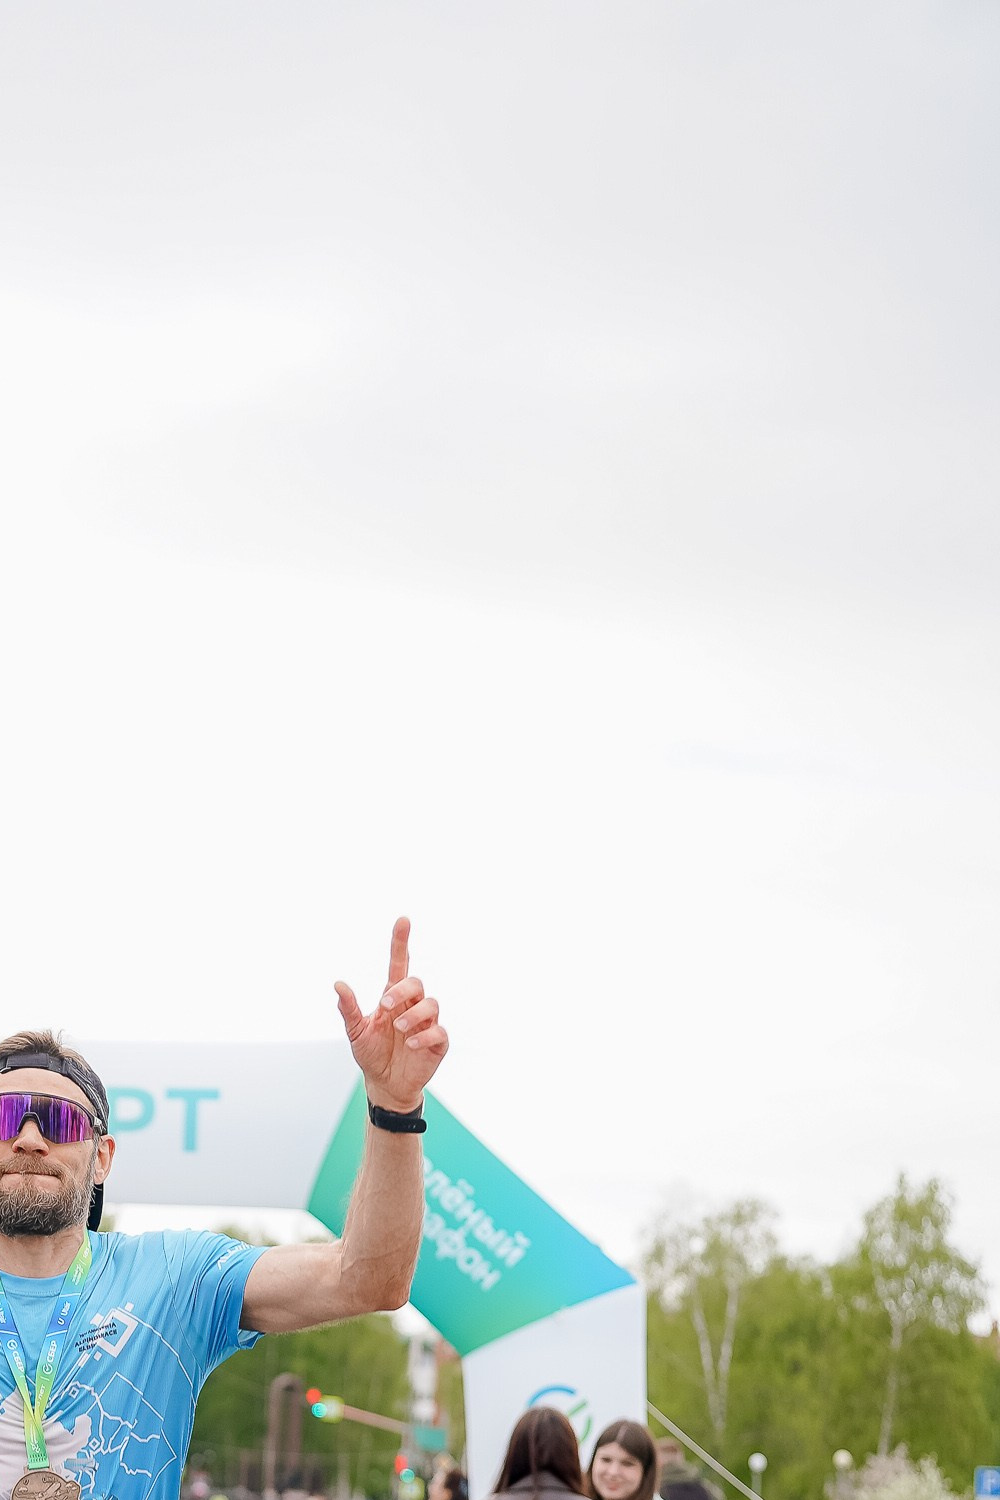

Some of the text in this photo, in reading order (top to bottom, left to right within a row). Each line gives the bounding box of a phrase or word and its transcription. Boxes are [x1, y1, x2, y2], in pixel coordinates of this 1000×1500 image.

[423, 1156, 531, 1269] лёный
[423, 1202, 502, 1292] афон
[46, 1339, 58, 1363] СБЕР
